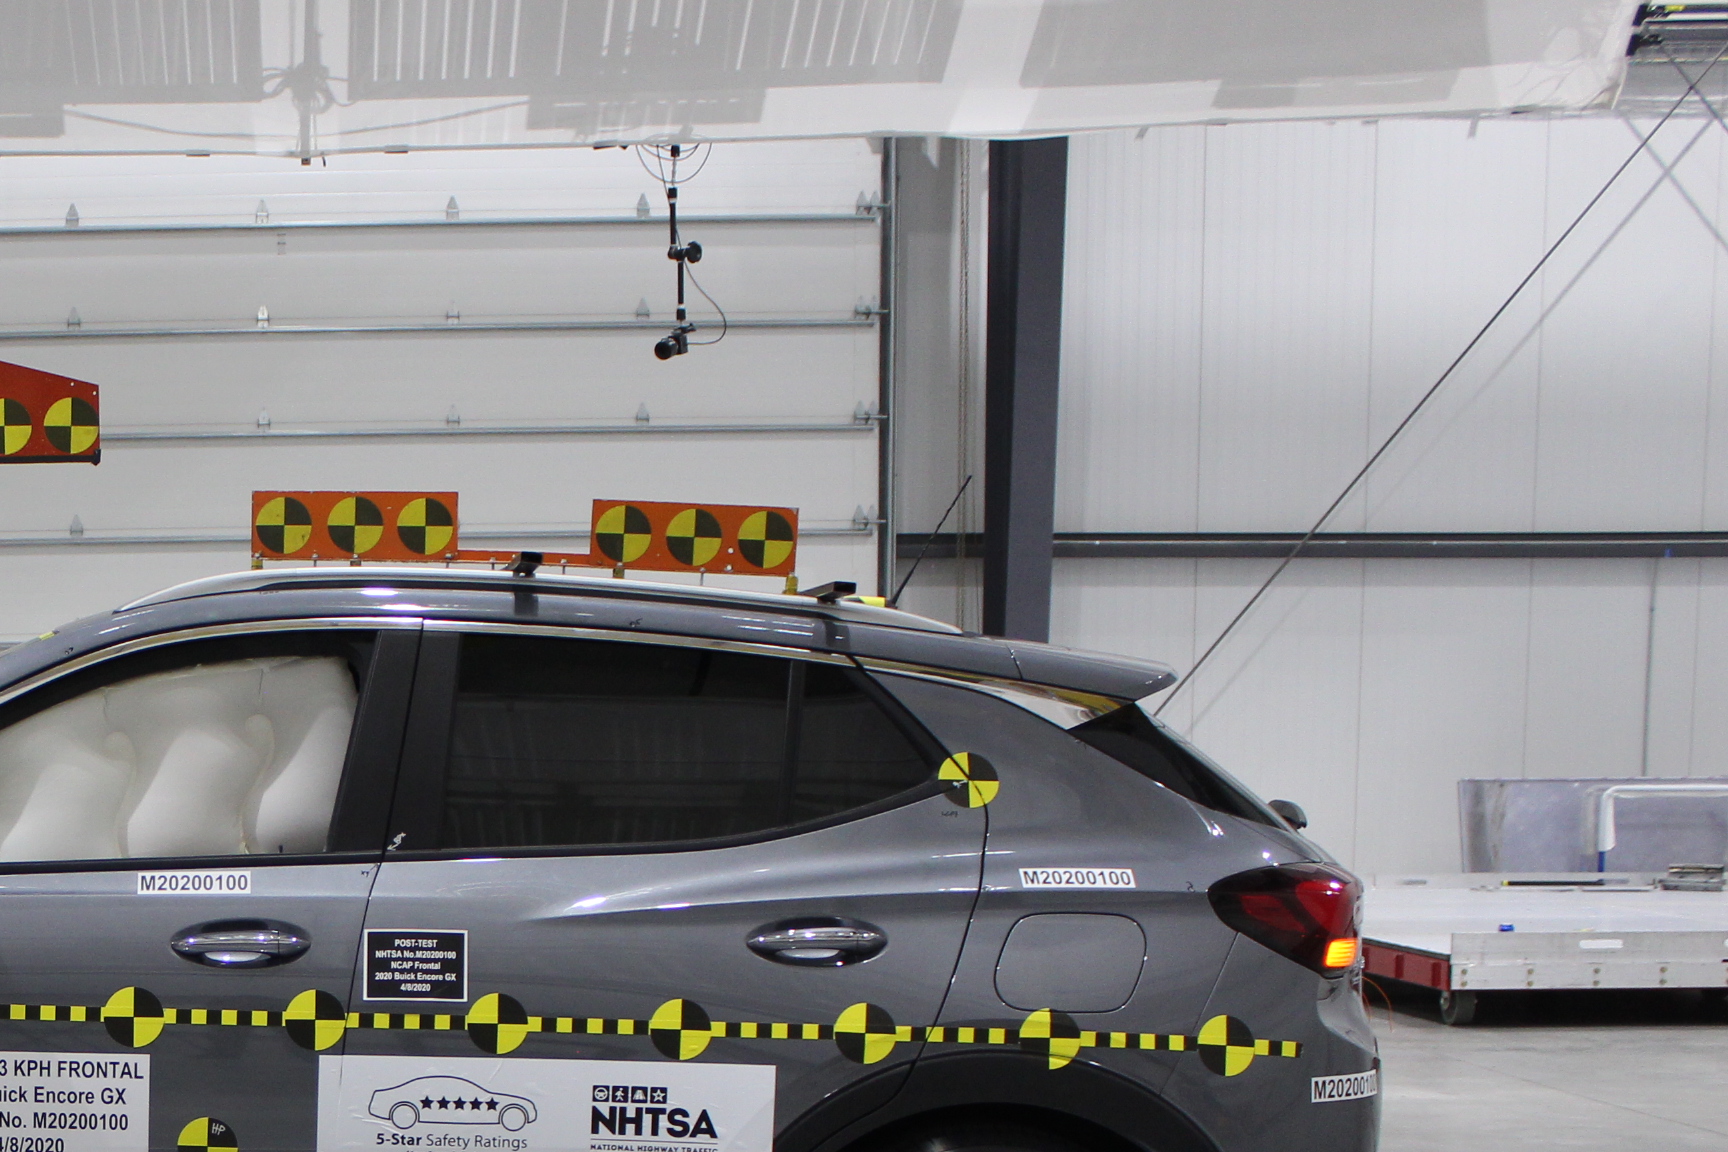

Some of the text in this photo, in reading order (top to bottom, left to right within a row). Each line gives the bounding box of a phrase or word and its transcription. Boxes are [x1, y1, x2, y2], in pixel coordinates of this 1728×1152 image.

[140, 874, 248, 891] M20200100
[1023, 871, 1131, 885] M20200100
[394, 939, 438, 948] POST-TEST
[375, 950, 402, 958] NHTSA
[391, 961, 441, 970] NCAP Frontal
[375, 972, 457, 981] 2020 Buick Encore GX
[400, 983, 431, 992] 4/8/2020
[14, 1059, 51, 1078] KPH
[57, 1060, 144, 1079] FRONTAL
[34, 1086, 94, 1104] Encore
[101, 1087, 127, 1105] GX
[33, 1112, 129, 1131] M20200100
[590, 1105, 718, 1139] NHTSA
[211, 1122, 226, 1136] HP
[376, 1133, 528, 1151] 5-Star Safety Ratings
[590, 1144, 634, 1152] NATIONAL
[637, 1145, 679, 1152] HIGHWAY
